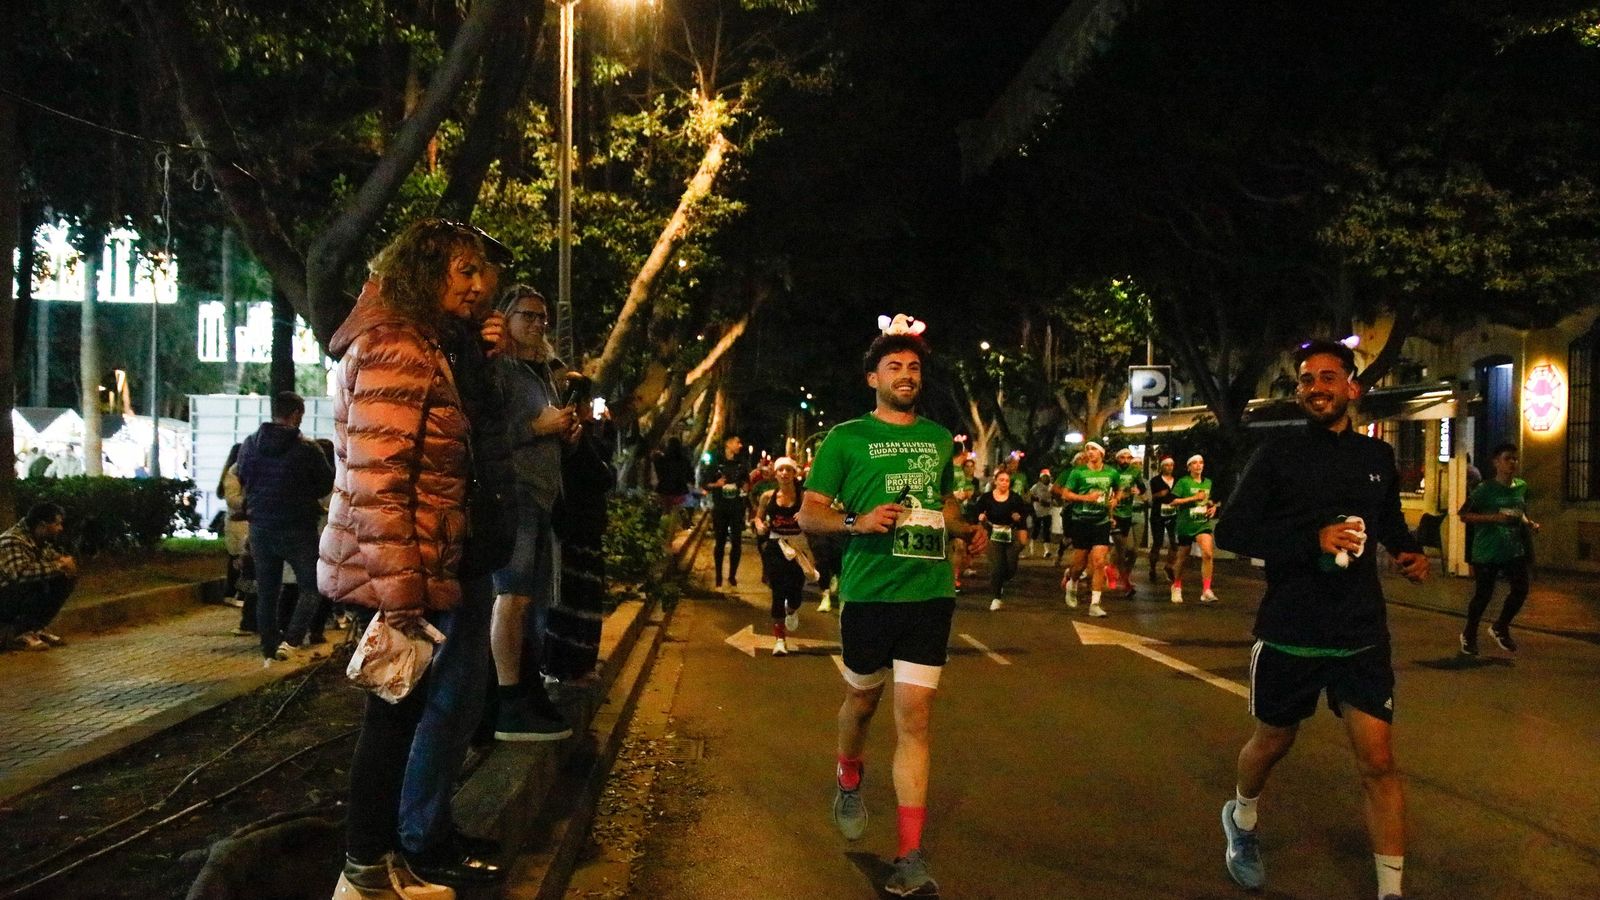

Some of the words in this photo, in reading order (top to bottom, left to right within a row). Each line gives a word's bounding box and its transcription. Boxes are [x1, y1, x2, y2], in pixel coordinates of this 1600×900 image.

[1132, 370, 1166, 407] P
[868, 442, 884, 450] XVII
[887, 478, 922, 486] PROTEGE
